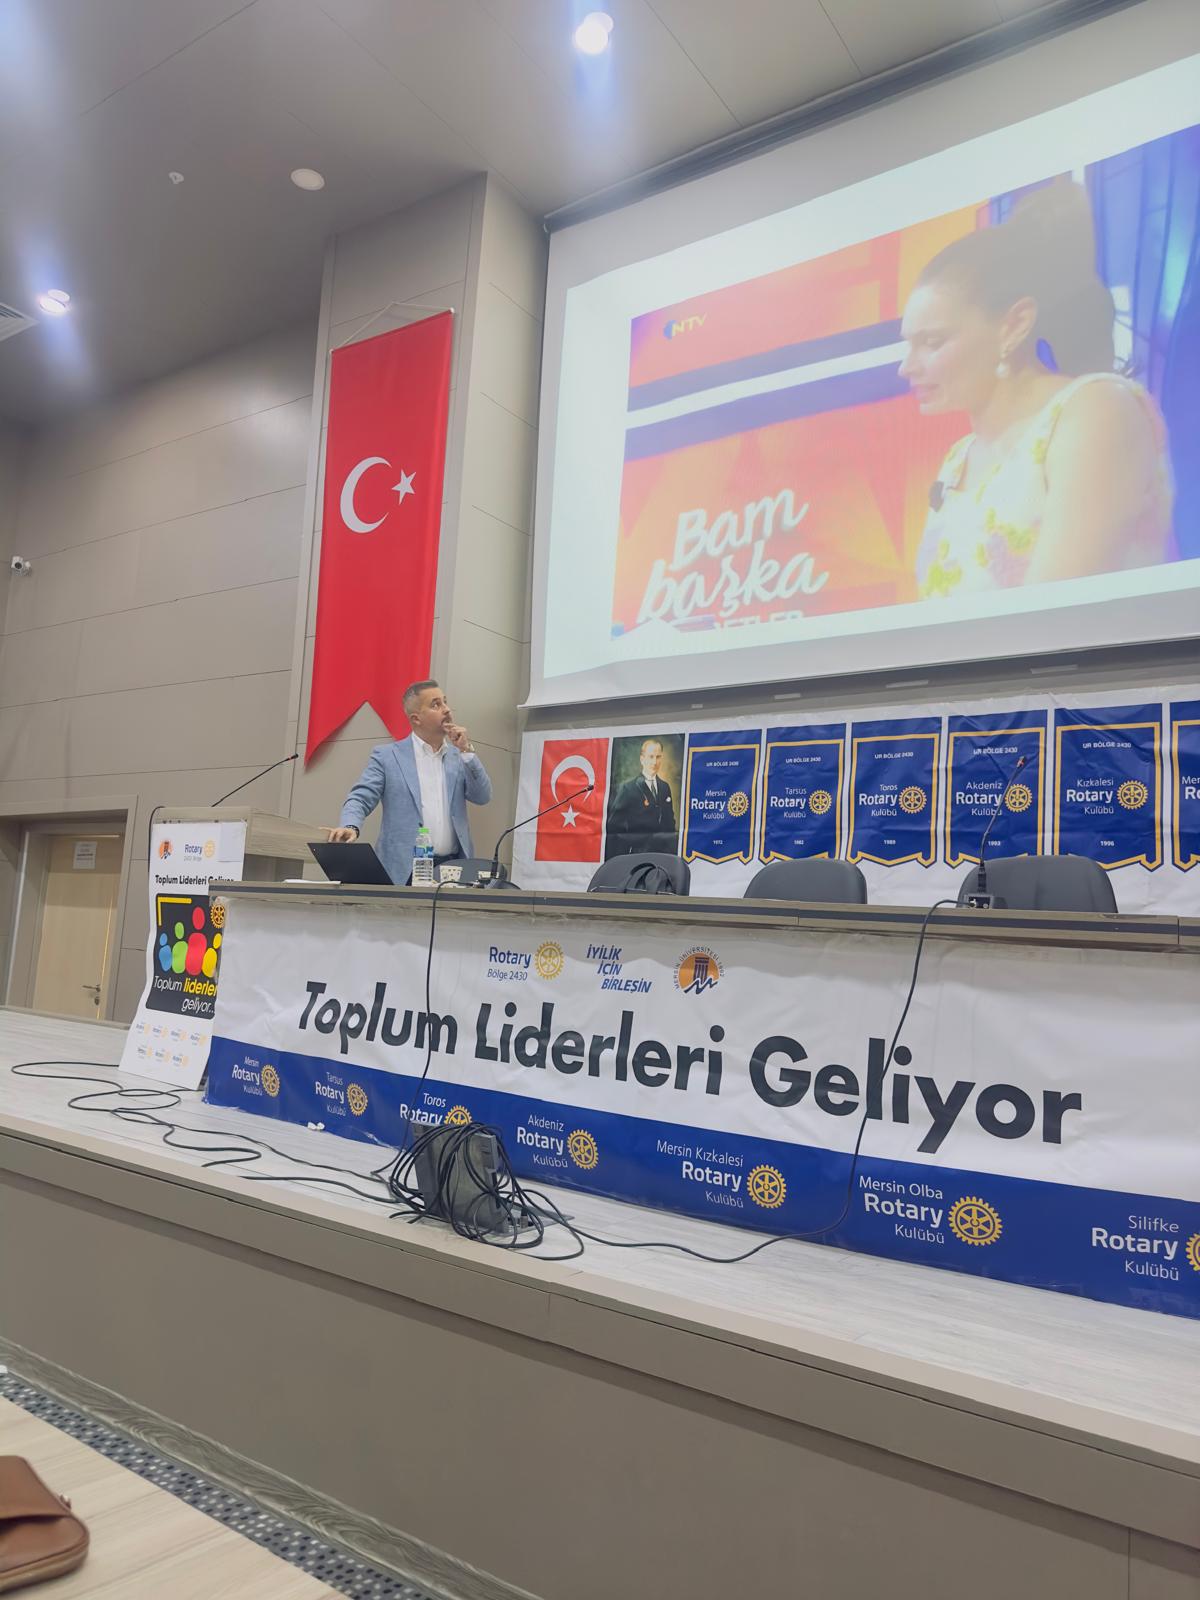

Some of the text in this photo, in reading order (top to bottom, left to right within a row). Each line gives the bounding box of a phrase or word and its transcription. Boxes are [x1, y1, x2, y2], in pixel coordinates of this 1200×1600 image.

[672, 312, 708, 337] NTV
[669, 488, 809, 571] Bam
[635, 540, 829, 624] başka
[966, 781, 1003, 790] Akdeniz
[1076, 777, 1114, 787] Kızkalesi
[785, 787, 807, 795] Tarsus
[956, 791, 1003, 807] Rotary
[1066, 789, 1113, 804] Rotary
[691, 798, 726, 812] Rotary
[770, 796, 806, 809] Rotary
[859, 793, 898, 807] Rotary
[703, 812, 725, 820] Kulübü
[871, 809, 897, 817] Kulübü
[1084, 806, 1114, 815] Kulübü
[184, 844, 203, 854] Rotary
[155, 874, 178, 886] Toplum
[179, 875, 207, 885] Liderleri
[489, 946, 531, 969] Rotary
[586, 944, 622, 961] İYİLİK
[487, 968, 528, 982] Bölge 2430
[597, 960, 622, 977] İÇİN
[153, 975, 183, 992] Toplum
[601, 977, 652, 994] BİRLEŞİN
[231, 1064, 260, 1086] Rotary
[298, 980, 1082, 1154] Toplum Liderleri Geliyor
[326, 1071, 343, 1085] Tarsus
[315, 1081, 344, 1104] Rotary
[423, 1092, 447, 1108] Toros
[400, 1103, 443, 1125] Rotary
[527, 1114, 564, 1132] Akdeniz
[517, 1127, 564, 1156] Rotary
[532, 1153, 568, 1168] Kulübü
[657, 1139, 744, 1168] Mersin Kızkalesi
[681, 1161, 743, 1192] Rotary
[859, 1175, 943, 1200] Mersin Olba
[705, 1190, 744, 1209] Kulübü
[864, 1192, 944, 1228] Rotary
[1128, 1215, 1179, 1233] Silifke
[894, 1223, 945, 1245] Kulübü
[1091, 1227, 1179, 1261] Rotary
[1125, 1259, 1179, 1281] Kulübü
